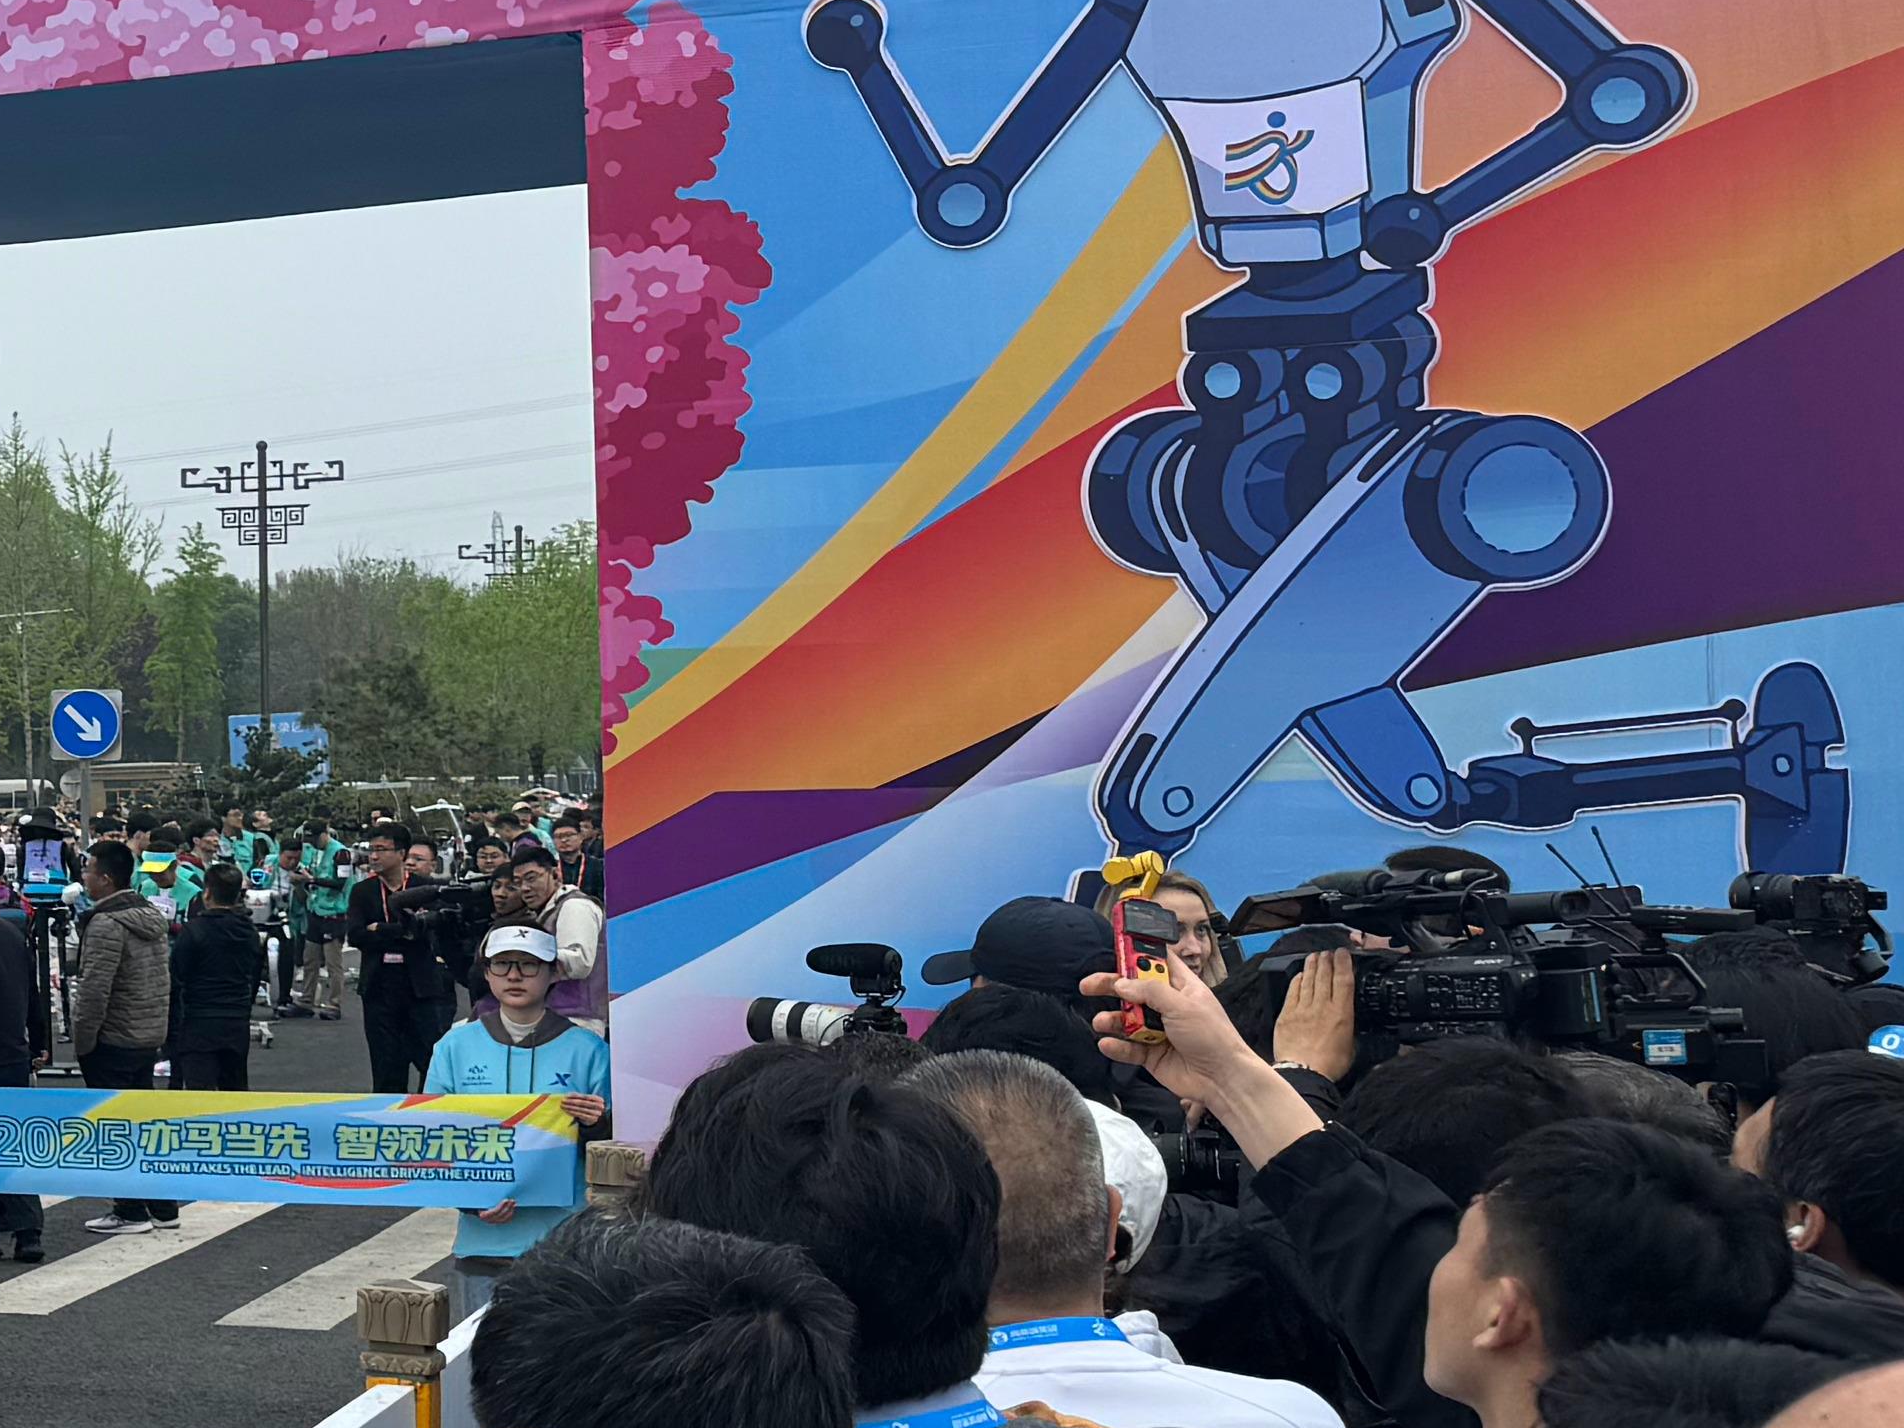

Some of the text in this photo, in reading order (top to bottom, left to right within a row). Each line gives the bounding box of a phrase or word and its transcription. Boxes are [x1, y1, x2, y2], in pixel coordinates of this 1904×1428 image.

[139, 1121, 517, 1164] 亦马当先 智领未来
